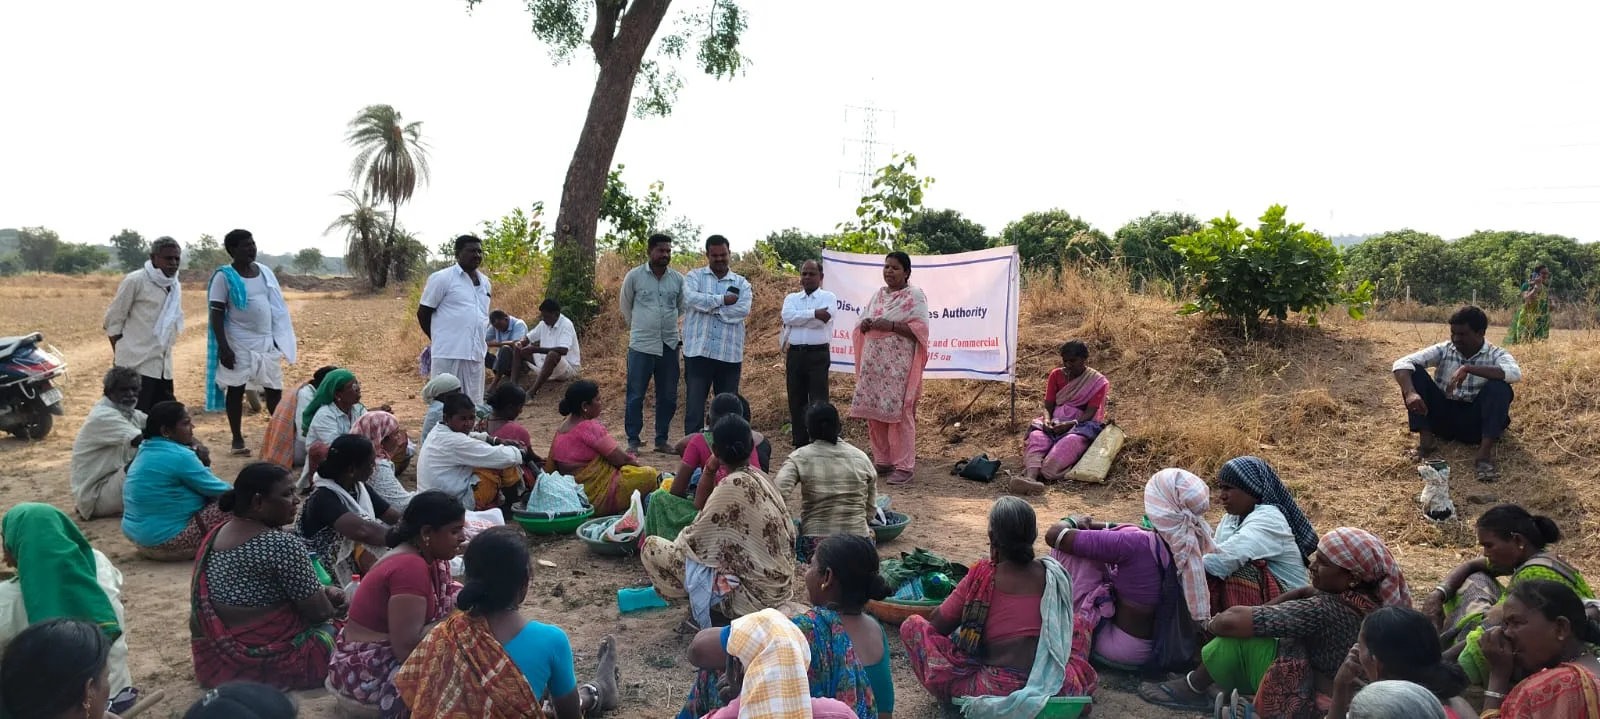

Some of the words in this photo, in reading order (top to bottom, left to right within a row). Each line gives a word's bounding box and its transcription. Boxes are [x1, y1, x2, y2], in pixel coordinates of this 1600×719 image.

[942, 306, 987, 319] Authority
[933, 338, 948, 348] and
[951, 337, 999, 348] Commercial
